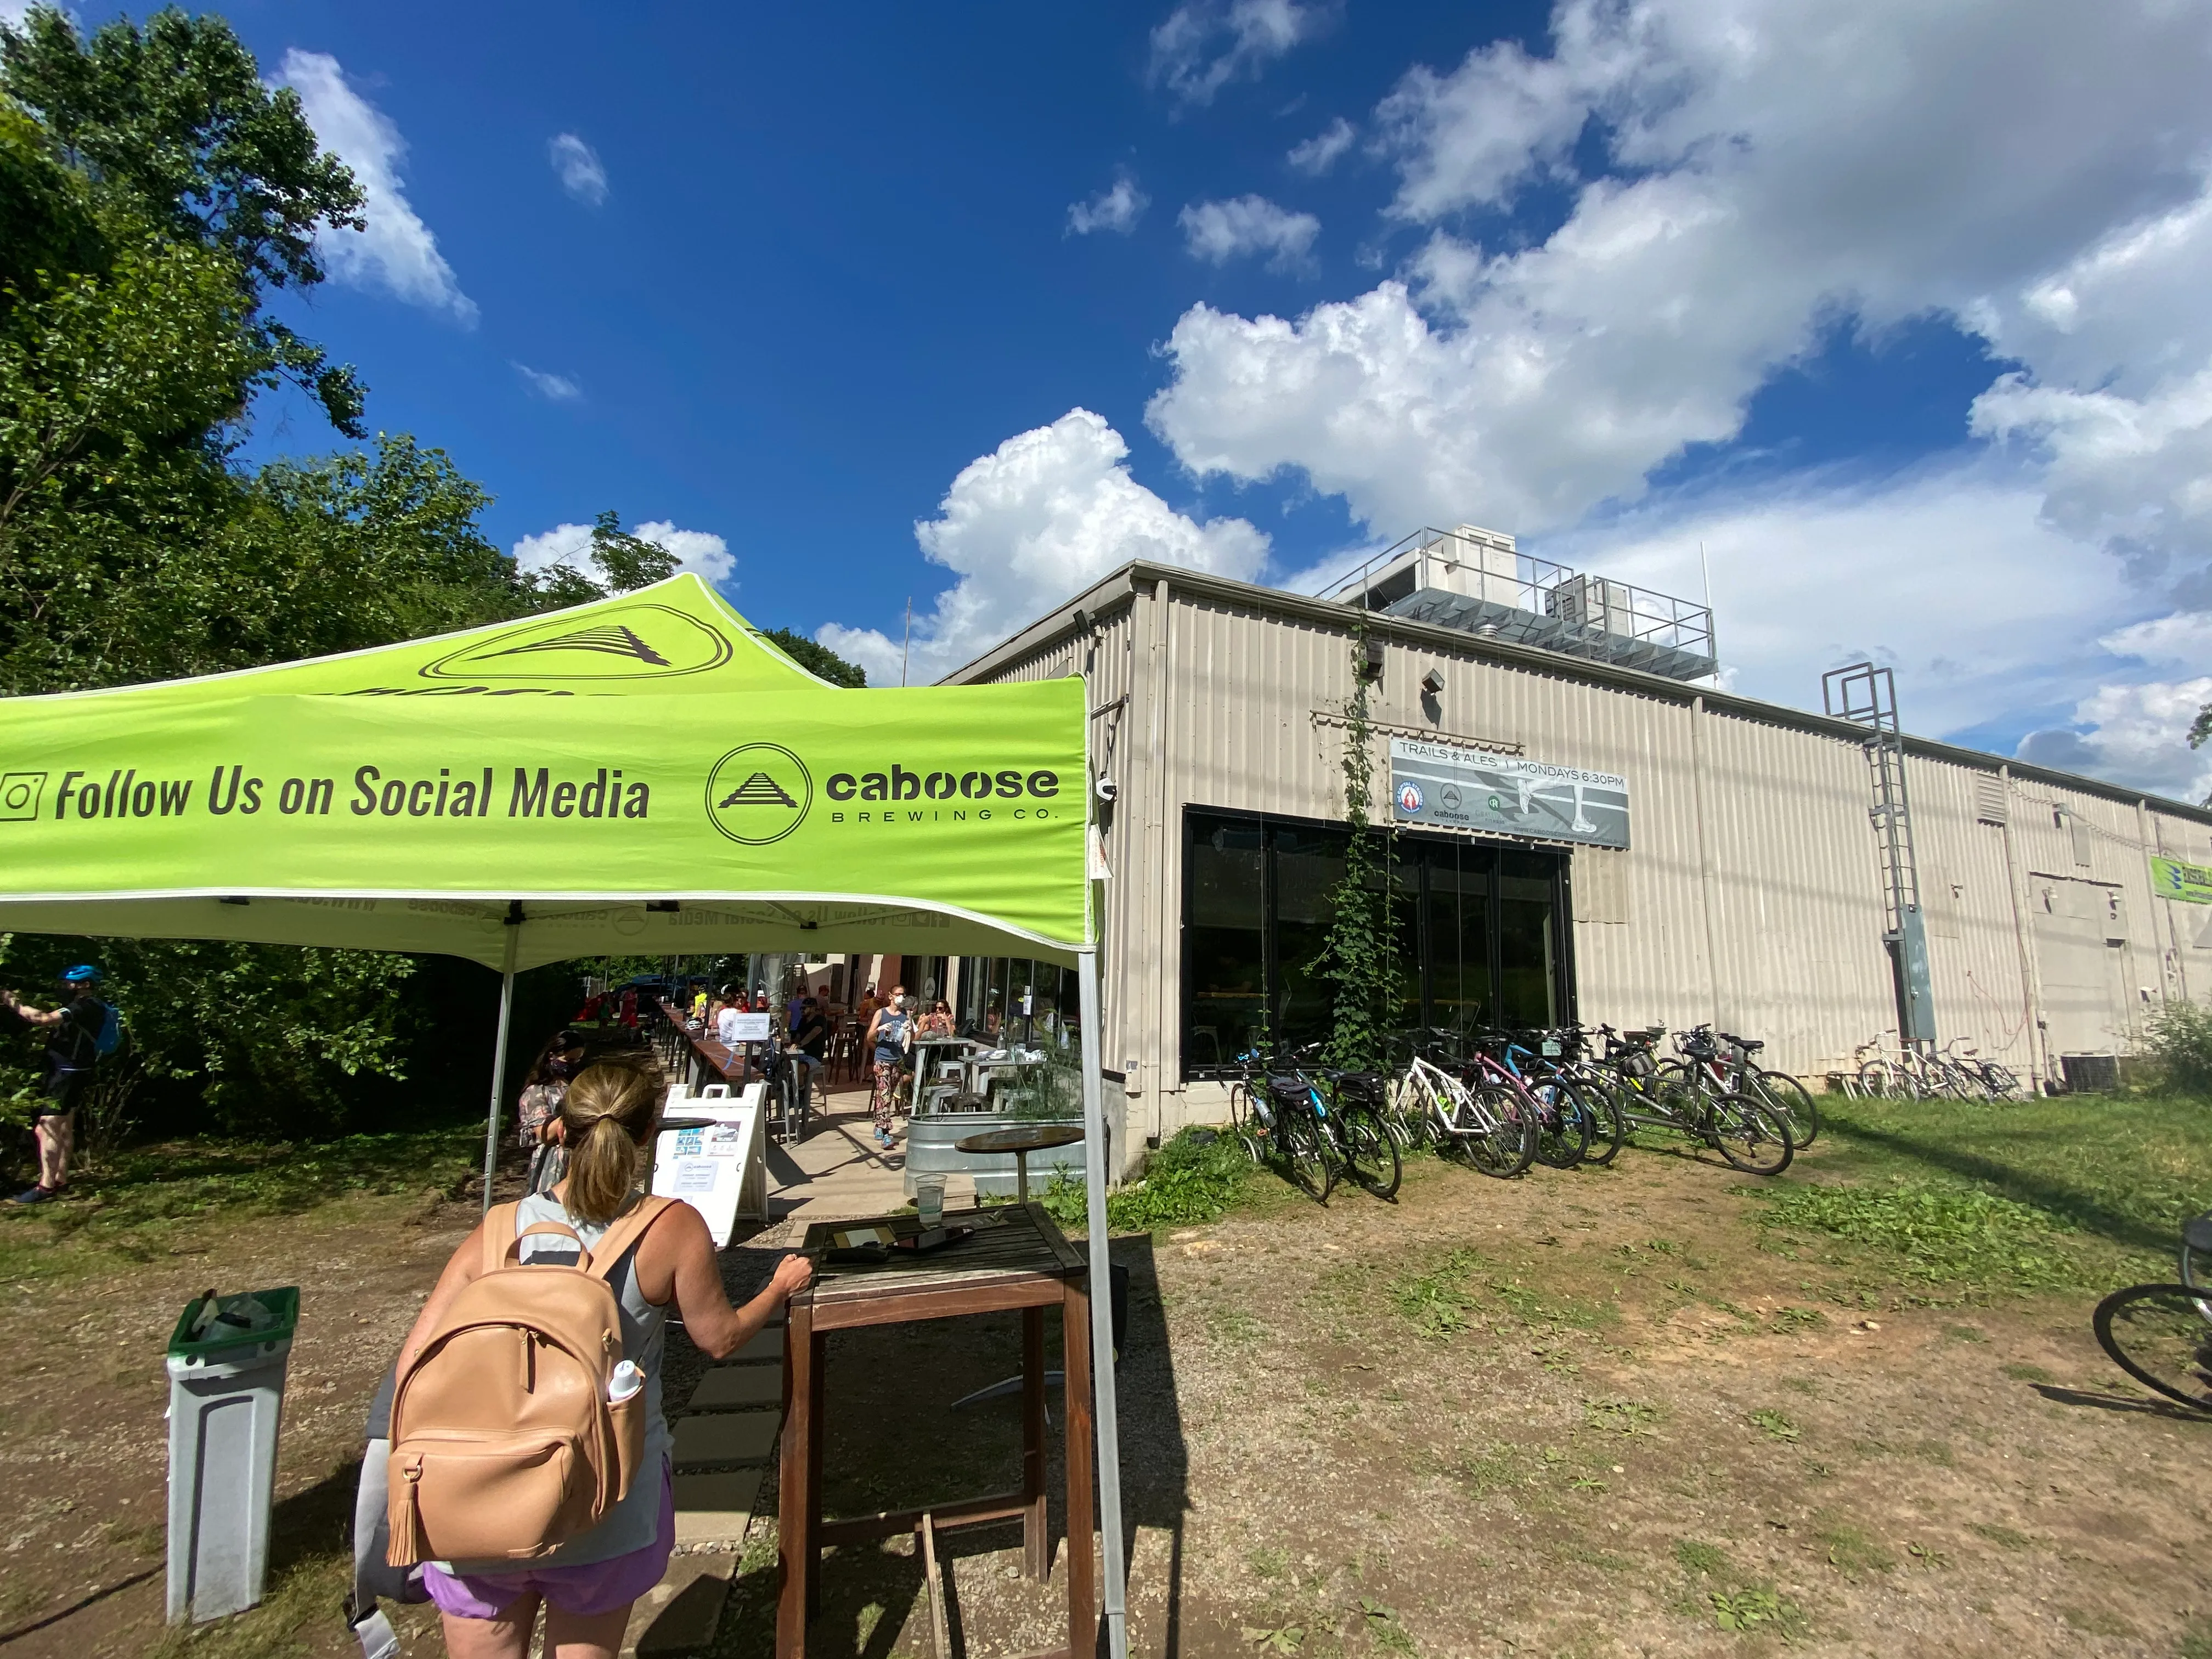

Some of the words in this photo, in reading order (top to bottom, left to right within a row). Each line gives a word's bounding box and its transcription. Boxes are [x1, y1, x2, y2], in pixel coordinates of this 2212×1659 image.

[827, 764, 1058, 800] caboose
[1400, 742, 1448, 759] TRAILS
[1452, 751, 1460, 761] &
[1464, 753, 1497, 767] ALES
[1517, 761, 1579, 780] MONDAYS
[1582, 772, 1624, 788] 6:30PM
[56, 770, 193, 819] Follow
[209, 766, 263, 814] Us
[280, 778, 333, 815] on
[351, 766, 492, 816] Social
[509, 768, 649, 818] Media
[832, 810, 991, 822] BREWING
[1014, 809, 1059, 819] CO.
[1434, 810, 1470, 821] caboose
